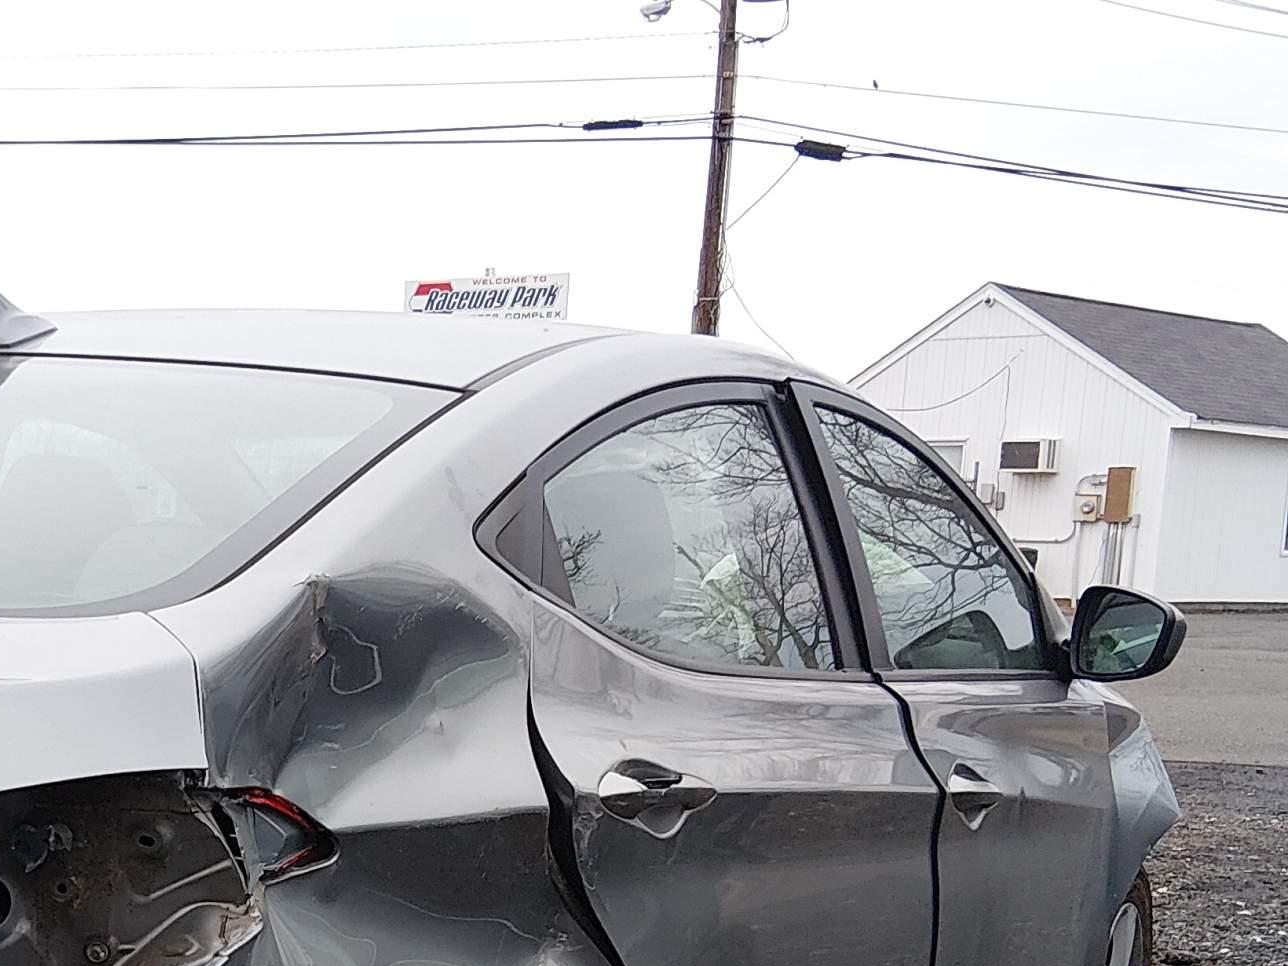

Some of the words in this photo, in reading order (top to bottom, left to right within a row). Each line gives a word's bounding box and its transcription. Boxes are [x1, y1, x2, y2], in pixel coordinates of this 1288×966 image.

[472, 277, 527, 286] WELCOME
[533, 275, 547, 283] TO
[424, 289, 511, 311] Raceway
[511, 284, 559, 308] Park
[505, 311, 562, 320] COMPLEX
